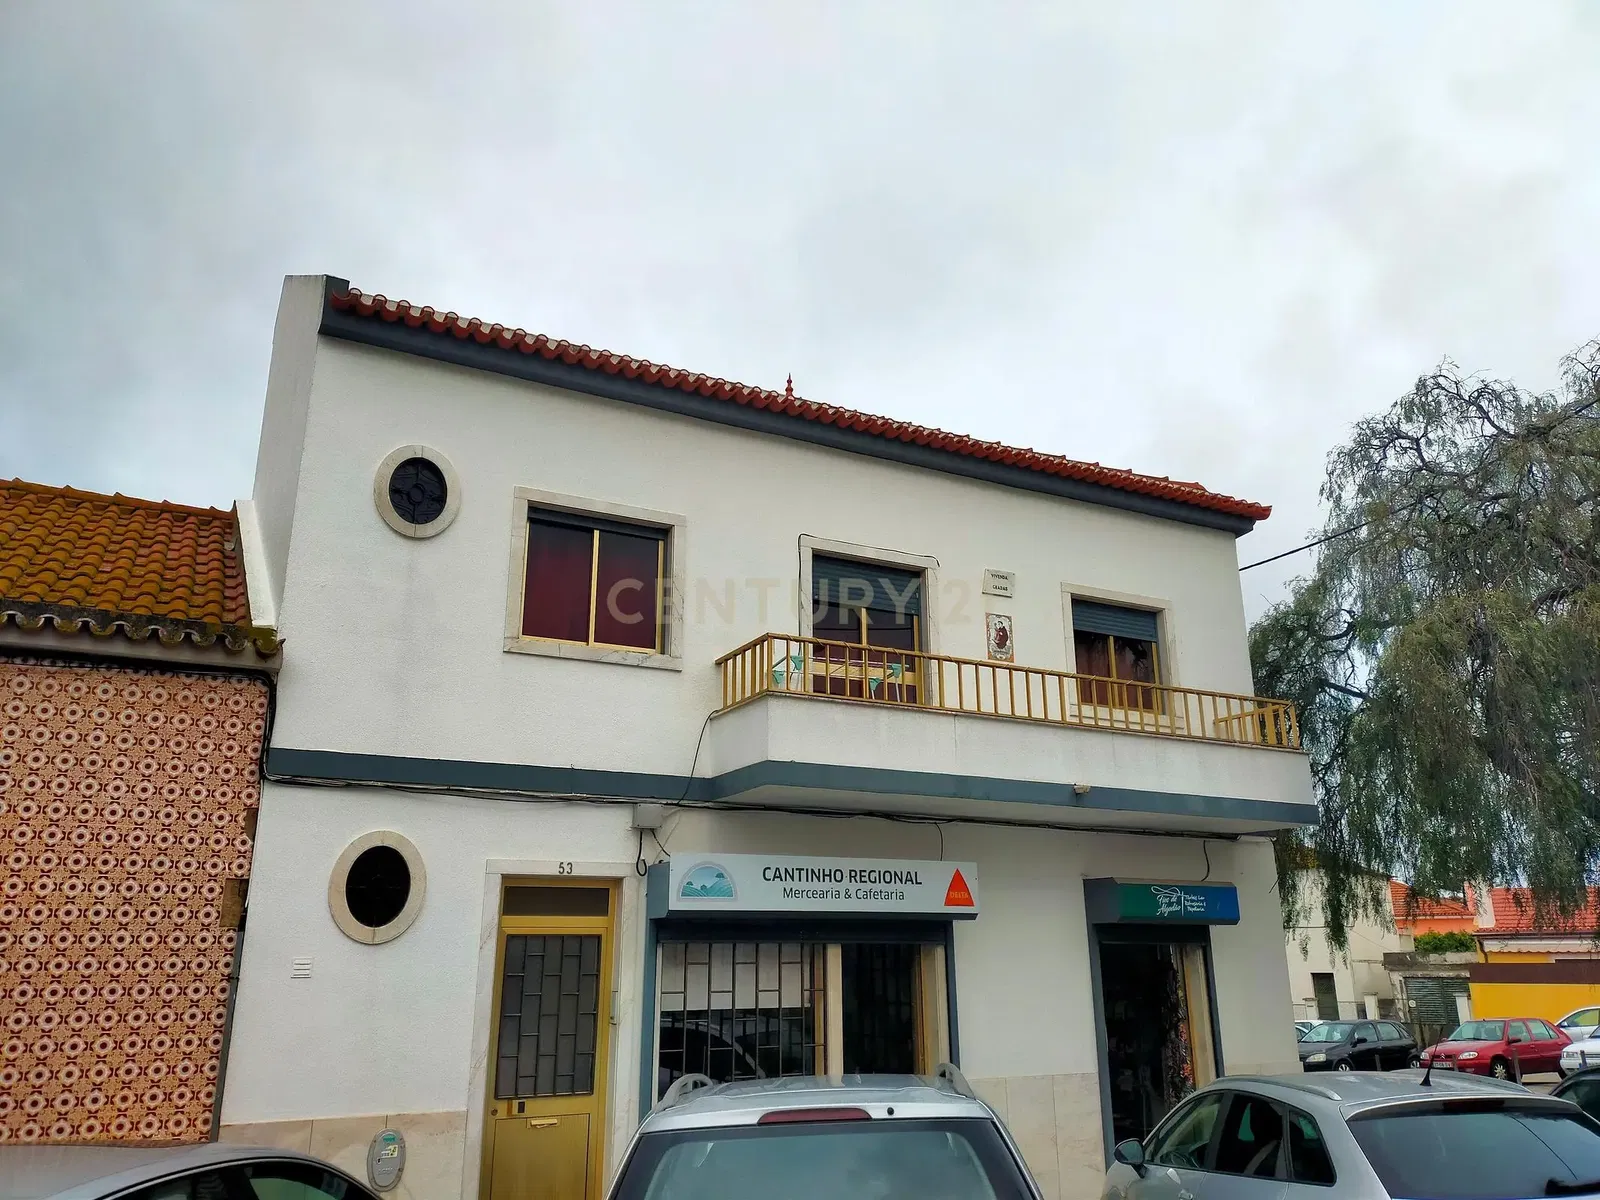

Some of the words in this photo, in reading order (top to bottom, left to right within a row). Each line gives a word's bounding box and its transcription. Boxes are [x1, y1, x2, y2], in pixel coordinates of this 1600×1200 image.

[558, 862, 573, 874] 53
[762, 866, 844, 883] CANTINHO
[848, 869, 922, 885] REGIONAL
[783, 887, 840, 899] Mercearia
[844, 888, 852, 899] &
[855, 888, 905, 900] Cafetaria
[949, 891, 969, 899] DELTA
